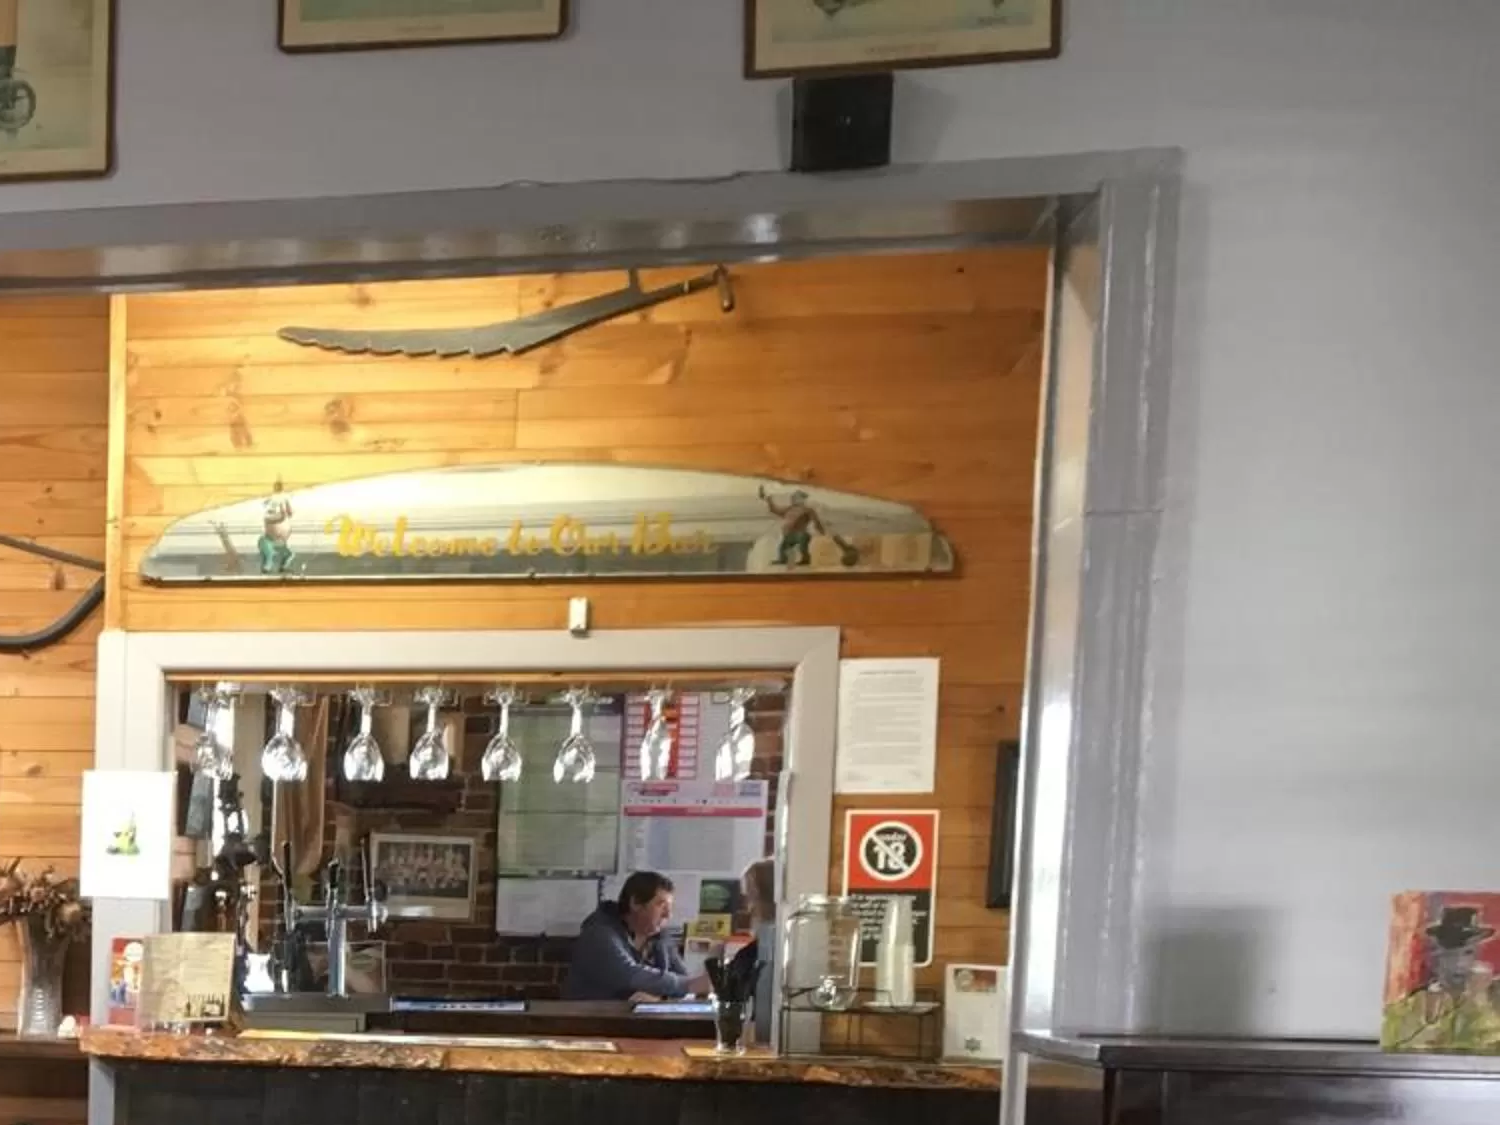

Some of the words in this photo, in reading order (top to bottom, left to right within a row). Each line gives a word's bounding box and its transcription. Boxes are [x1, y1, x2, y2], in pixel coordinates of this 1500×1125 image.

[323, 513, 497, 557] Welcome
[549, 512, 620, 557] Our
[630, 511, 718, 556] Bar
[873, 842, 906, 870] 18
